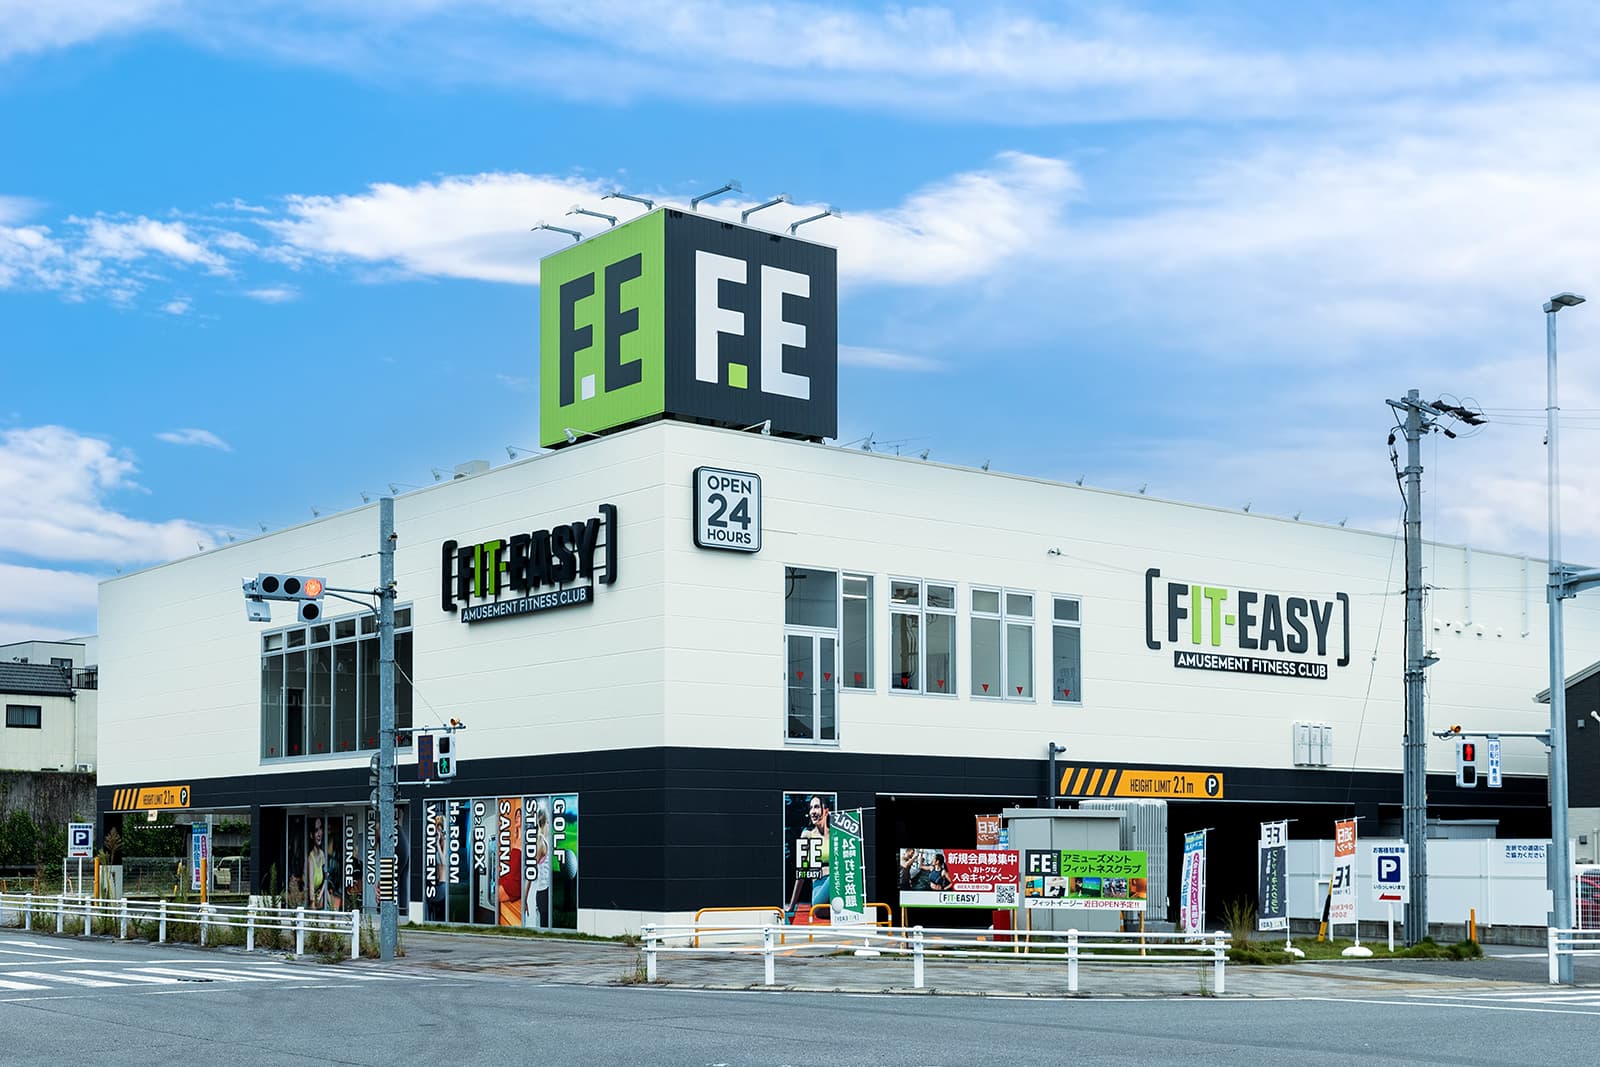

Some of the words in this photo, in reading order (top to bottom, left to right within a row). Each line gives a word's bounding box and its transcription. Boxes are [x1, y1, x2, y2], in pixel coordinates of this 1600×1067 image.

[707, 475, 752, 495] OPEN
[707, 493, 752, 530] 24
[707, 527, 752, 545] HOURS
[462, 601, 518, 622] AMUSEMENT
[519, 593, 558, 612] FITNESS
[559, 587, 587, 603] CLUB
[1177, 652, 1250, 670] AMUSEMENT
[1251, 658, 1297, 676] FITNESS
[1298, 663, 1327, 678] CLUB
[1130, 779, 1153, 792] HEIGHT
[1154, 780, 1171, 793] LIMIT
[75, 832, 87, 844] P
[500, 801, 511, 876] SAUNA
[526, 800, 537, 880] STUDIO
[553, 799, 566, 864] GOLF
[345, 815, 354, 888] LOUNGE
[426, 804, 437, 898] WOMEN'S
[948, 853, 1017, 865] 新規会員募集中
[1063, 854, 1132, 863] アミューズメント
[952, 873, 1017, 882] 入会キャンペーン
[1063, 864, 1142, 874] フィットネスクラブ
[1381, 859, 1397, 880] P
